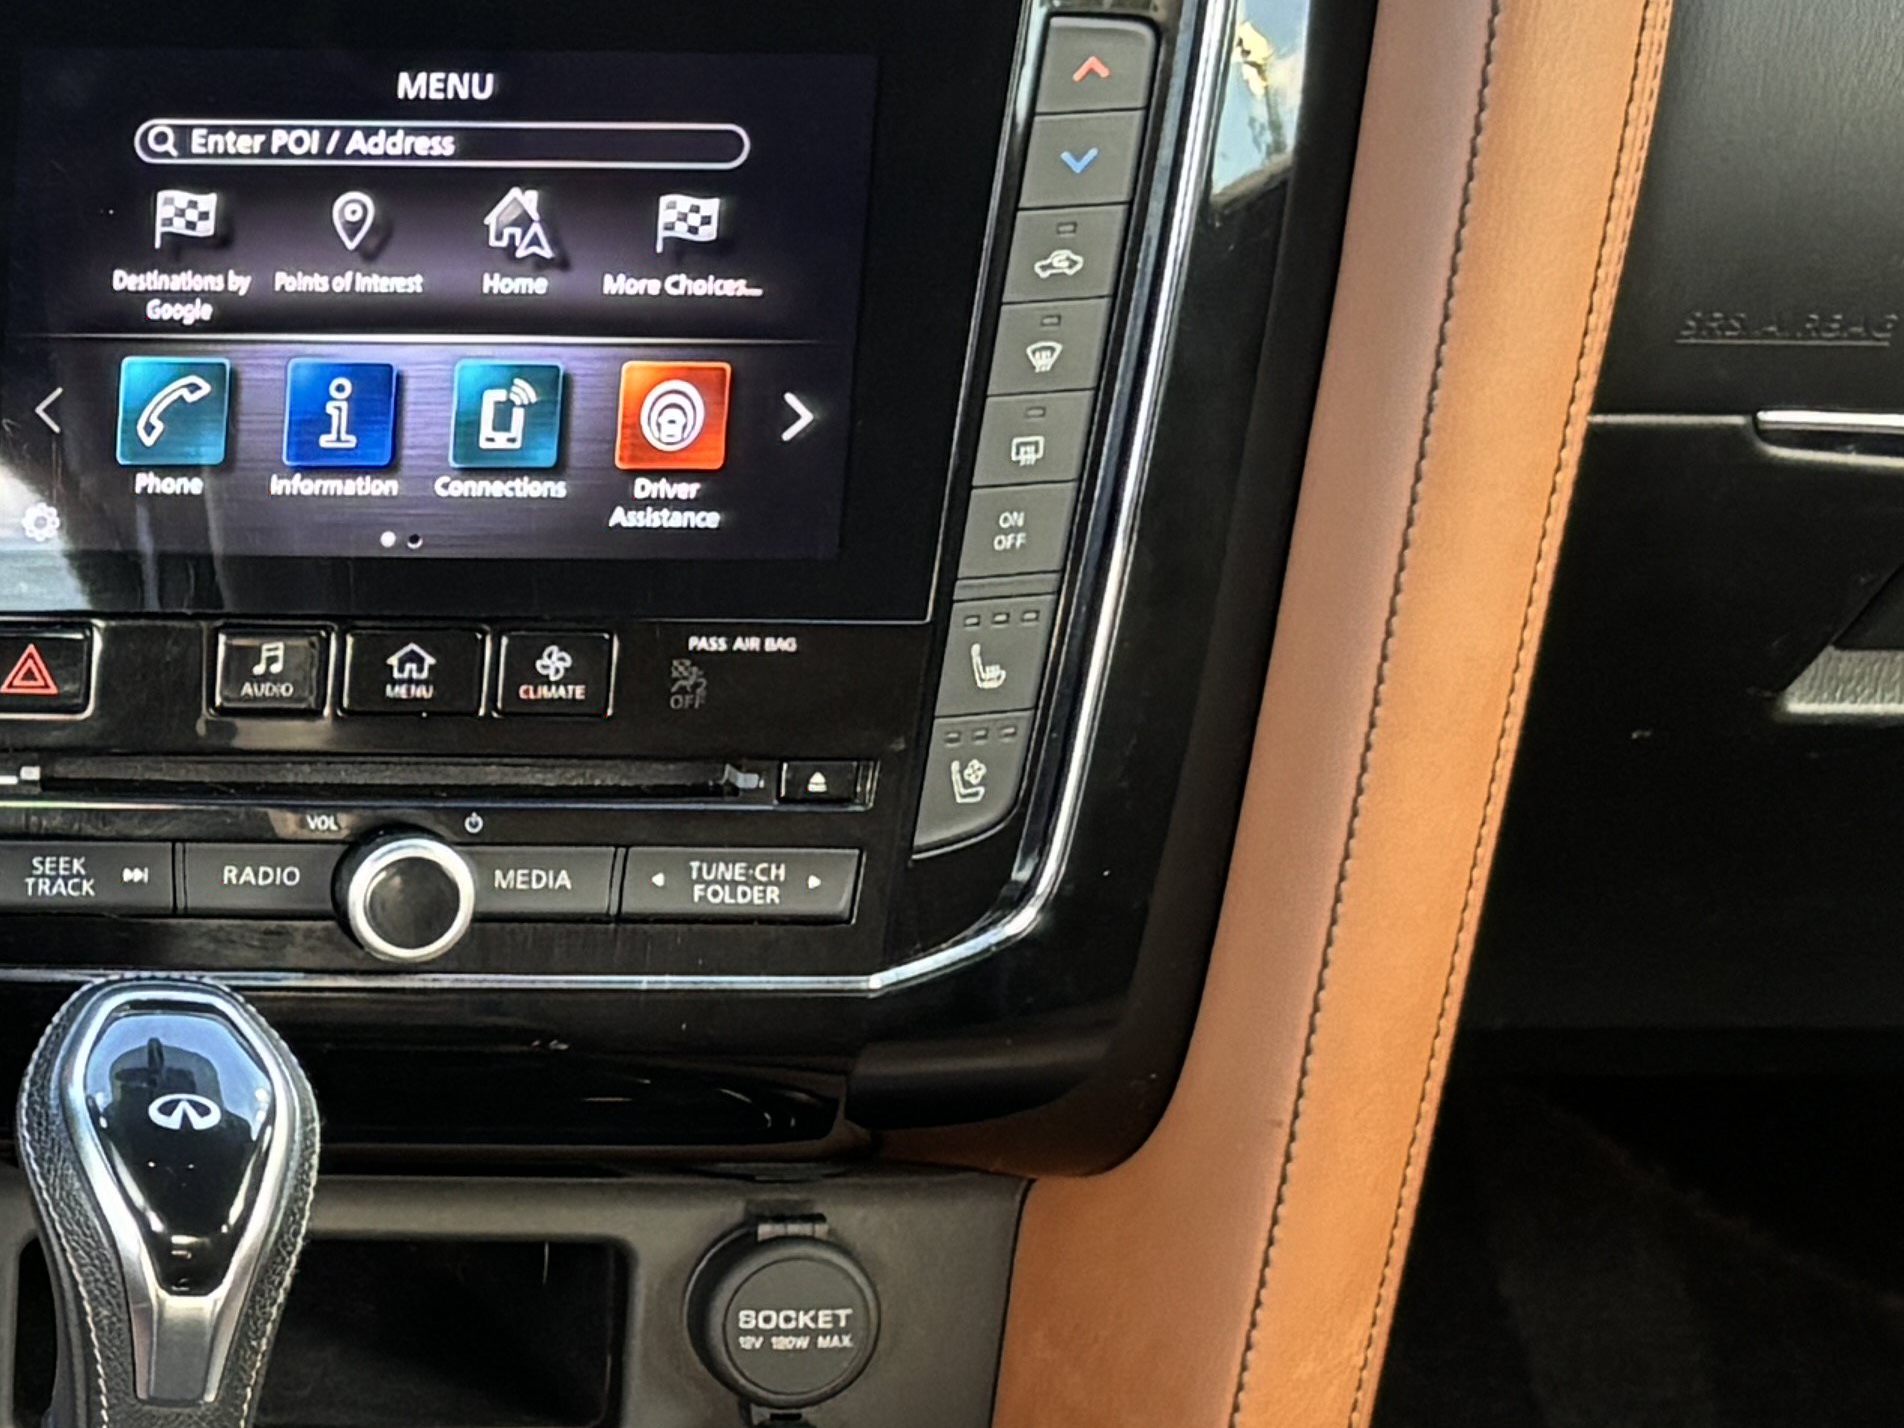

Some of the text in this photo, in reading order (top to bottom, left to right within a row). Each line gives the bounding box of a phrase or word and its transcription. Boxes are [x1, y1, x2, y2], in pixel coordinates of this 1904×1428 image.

[396, 71, 495, 101] MENU
[190, 129, 267, 156] Enter
[270, 130, 321, 156] POI
[345, 129, 456, 157] Address
[112, 269, 252, 297] Destinations by
[274, 272, 424, 294] Points of Interest
[481, 273, 549, 296] Home
[602, 274, 662, 297] More
[145, 299, 213, 325] Google
[134, 472, 205, 496] Phone
[269, 474, 399, 497] Information
[433, 476, 568, 500] Connections
[633, 477, 702, 501] Driver
[608, 506, 722, 530] Assistance
[998, 511, 1025, 529] ON
[993, 533, 1027, 552] OFF
[687, 635, 798, 653] PASS AIR BAG
[240, 681, 294, 699] AUDIO
[385, 683, 435, 701] MENU
[518, 684, 586, 701] CLIMATE
[306, 814, 339, 831] VOL
[31, 856, 87, 876] SEEK
[222, 865, 301, 887] RADIO
[23, 877, 96, 898] TRACK
[493, 869, 572, 892] MEDIA
[693, 884, 781, 905] FOLDER
[737, 1307, 854, 1330] SOCKET
[816, 1333, 853, 1349] MAX
